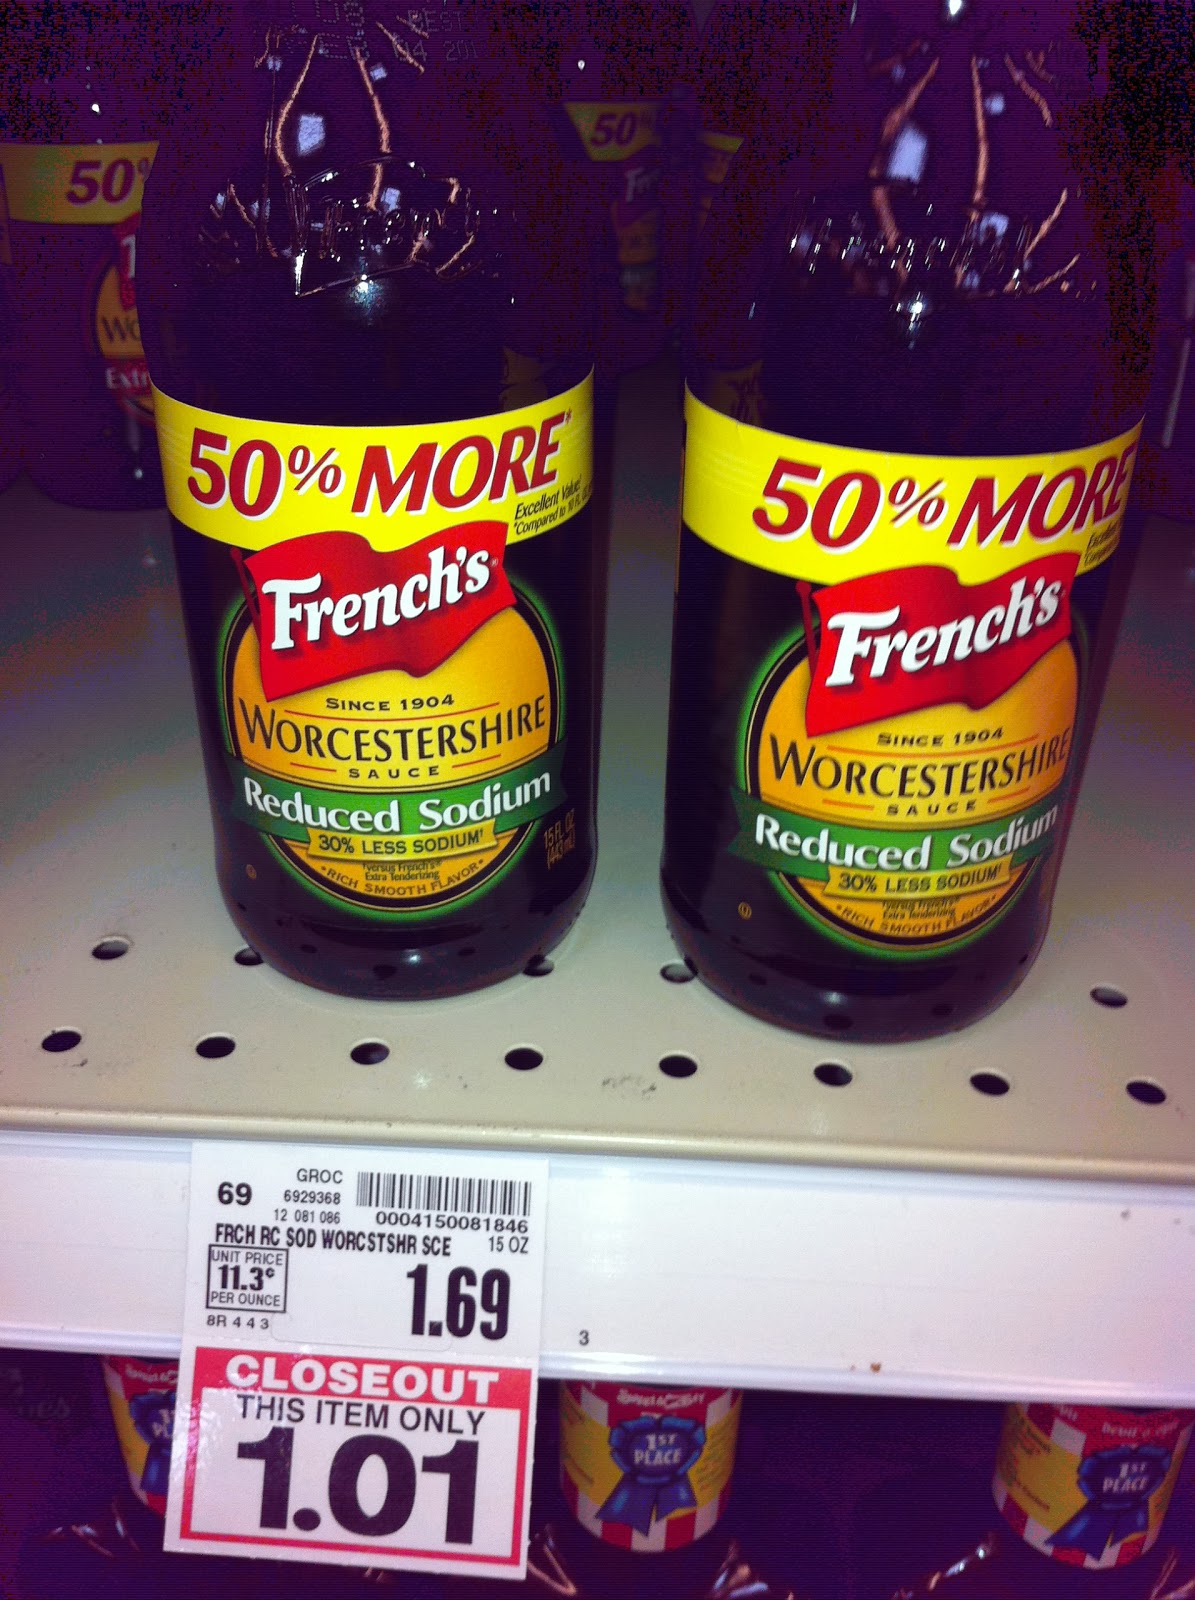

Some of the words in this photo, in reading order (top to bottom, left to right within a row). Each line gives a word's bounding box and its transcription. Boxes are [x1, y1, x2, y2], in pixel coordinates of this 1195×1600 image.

[187, 427, 344, 519] 50%
[514, 490, 560, 520] Excellent
[752, 457, 948, 553] 50%
[261, 545, 492, 651] French's
[825, 577, 1064, 687] French's
[399, 693, 456, 711] 1904
[238, 694, 547, 763] WORCESTERSHIRE
[953, 726, 1004, 746] 1904
[348, 764, 440, 779] SAUCE
[243, 777, 400, 833] Reduced
[418, 770, 551, 831] Sodium
[886, 799, 977, 817] SAUCE
[318, 834, 355, 854] 30%
[361, 840, 407, 855] LESS
[755, 812, 931, 872] Reduced
[946, 804, 1058, 869] Sodium
[327, 867, 360, 889] RICH
[364, 883, 427, 897] SMOOTH
[430, 861, 480, 893] FLAVOR
[838, 872, 877, 893] 30%
[885, 877, 931, 893] LESS
[296, 1168, 344, 1184] GROC
[217, 1181, 253, 1206] 69
[283, 1189, 342, 1206] 6929368
[273, 1209, 288, 1223] 12
[294, 1209, 316, 1224] 081
[319, 1211, 341, 1225] 086
[375, 1210, 529, 1234] 0004150081846
[215, 1222, 256, 1246] FRCH
[260, 1226, 280, 1248] RC
[285, 1228, 317, 1250] SOD
[321, 1229, 417, 1254] WORCSTSHR
[421, 1235, 451, 1257] SCE
[488, 1236, 505, 1253] 15
[508, 1236, 529, 1254] OZ
[210, 1249, 241, 1264] UNIT
[244, 1251, 284, 1266] PRICE
[210, 1292, 236, 1305] PER
[238, 1293, 281, 1308] OUNCE
[406, 1263, 511, 1341] 1.69
[579, 1329, 590, 1346] 3
[225, 1354, 499, 1404] CLOSEOUT
[237, 1394, 305, 1423] THIS
[315, 1398, 389, 1429] ITEM
[400, 1406, 486, 1436] ONLY
[633, 1447, 683, 1466] PLACE
[236, 1425, 480, 1545] 1.01
